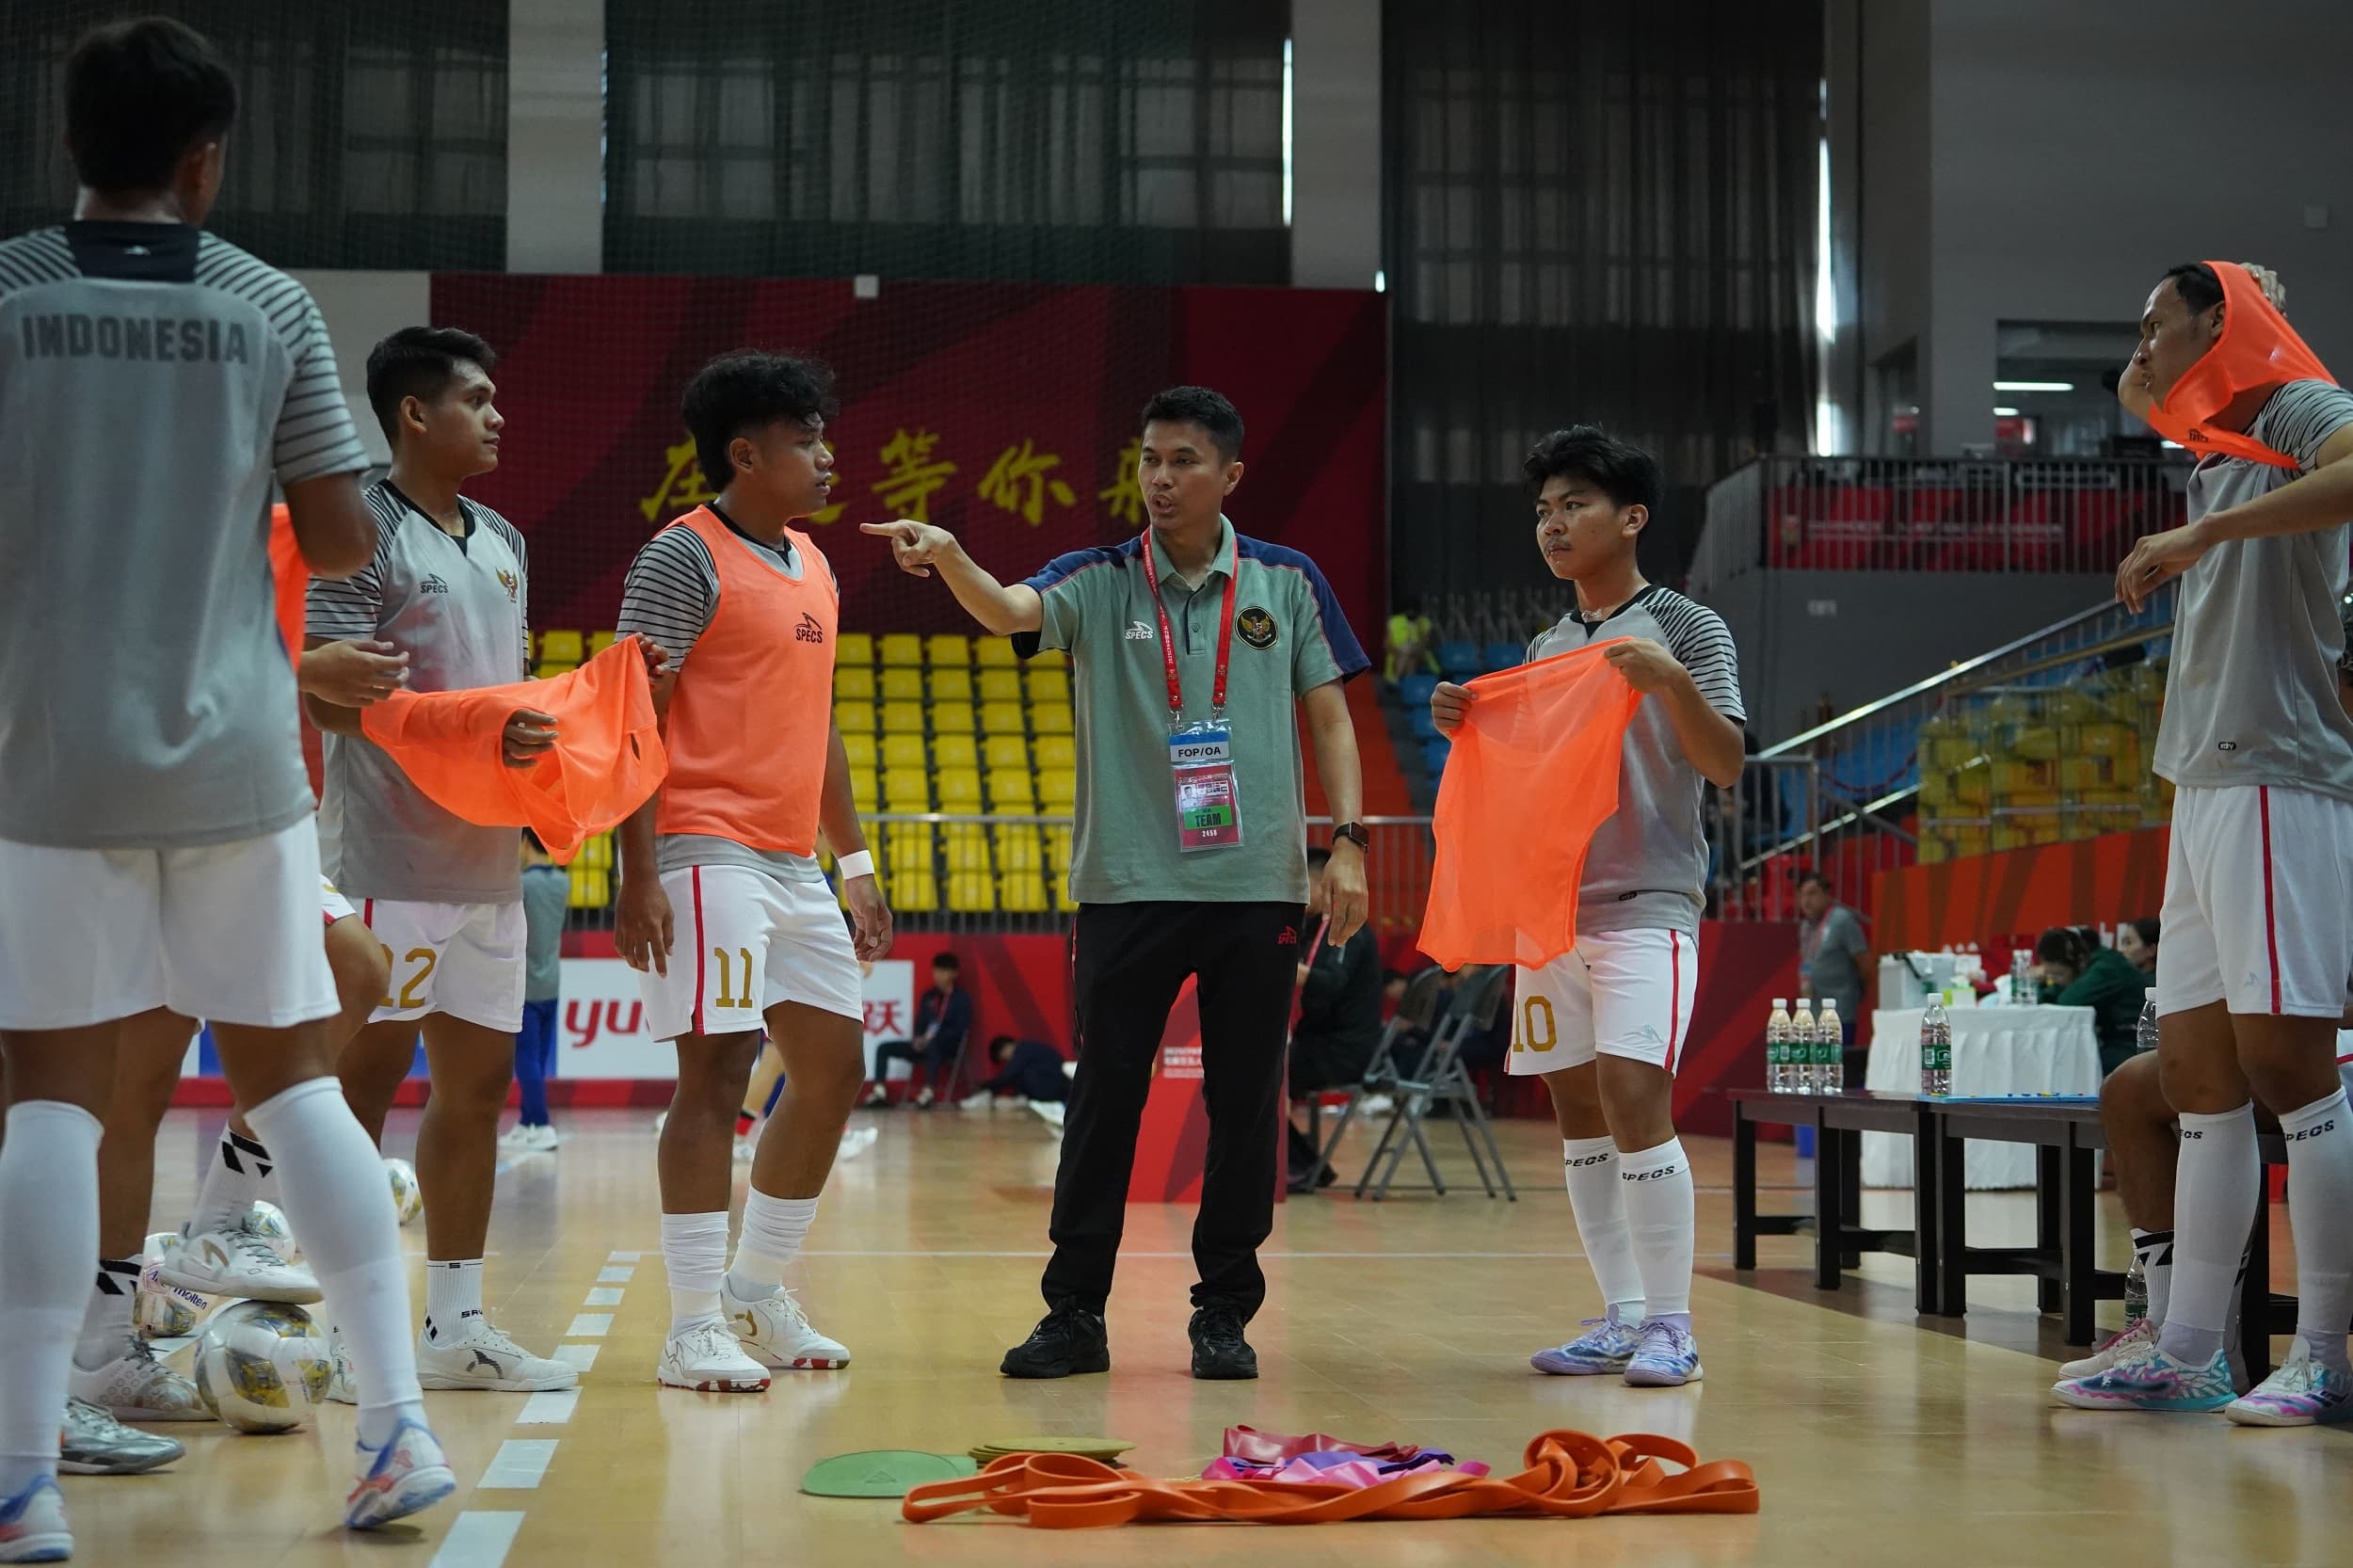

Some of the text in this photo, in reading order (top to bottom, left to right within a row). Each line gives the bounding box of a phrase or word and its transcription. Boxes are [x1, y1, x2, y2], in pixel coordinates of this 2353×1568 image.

[21, 313, 249, 365] INDONESIA
[420, 584, 449, 594] SPECS
[795, 628, 823, 644] SPECS
[1125, 631, 1154, 640] SPECS
[1177, 746, 1222, 758] FOP/OA
[1195, 812, 1222, 828] TEAM
[713, 947, 754, 1009] 11
[1513, 995, 1558, 1052] 10
[2285, 1119, 2335, 1142] PECS
[1564, 1153, 1609, 1167] PECS
[173, 1288, 208, 1310] molten
